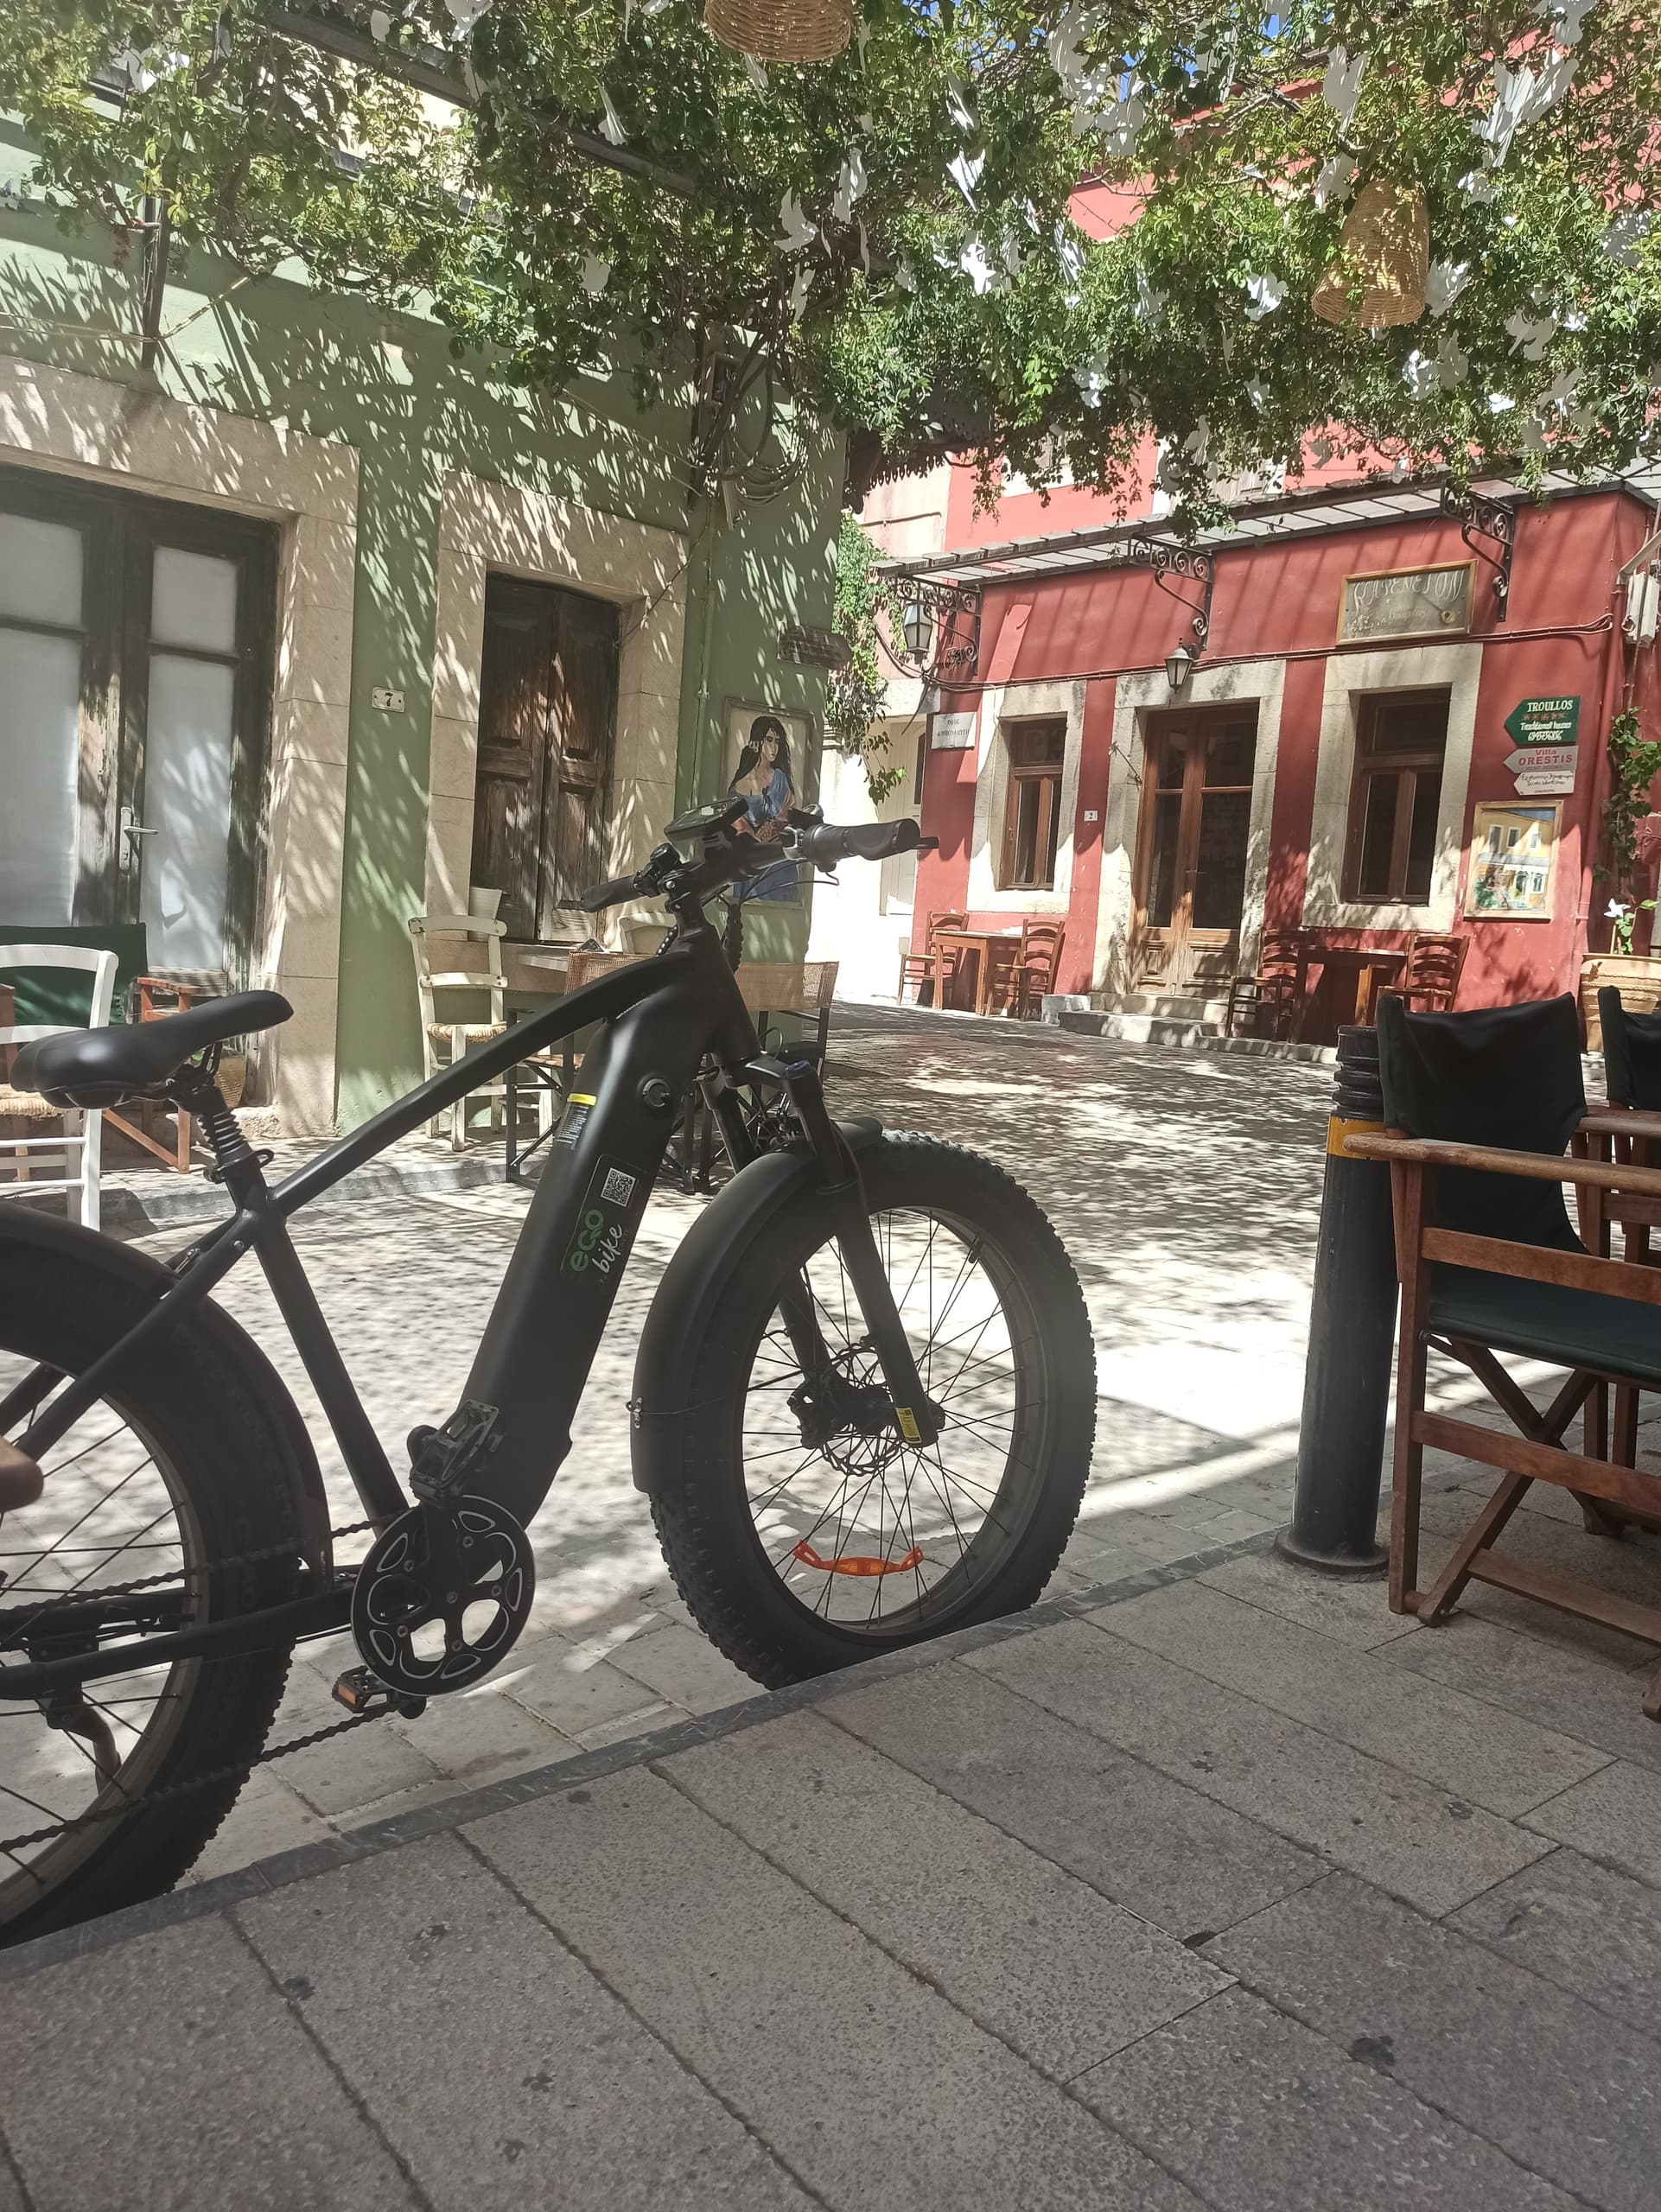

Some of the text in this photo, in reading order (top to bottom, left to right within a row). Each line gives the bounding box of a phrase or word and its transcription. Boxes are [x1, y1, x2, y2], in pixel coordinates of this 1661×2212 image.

[385, 692, 394, 707] 7
[1527, 700, 1573, 712] TROULLOS
[1518, 754, 1573, 766] ORESTIS
[570, 1210, 604, 1272] eco
[592, 1224, 623, 1274] bike
